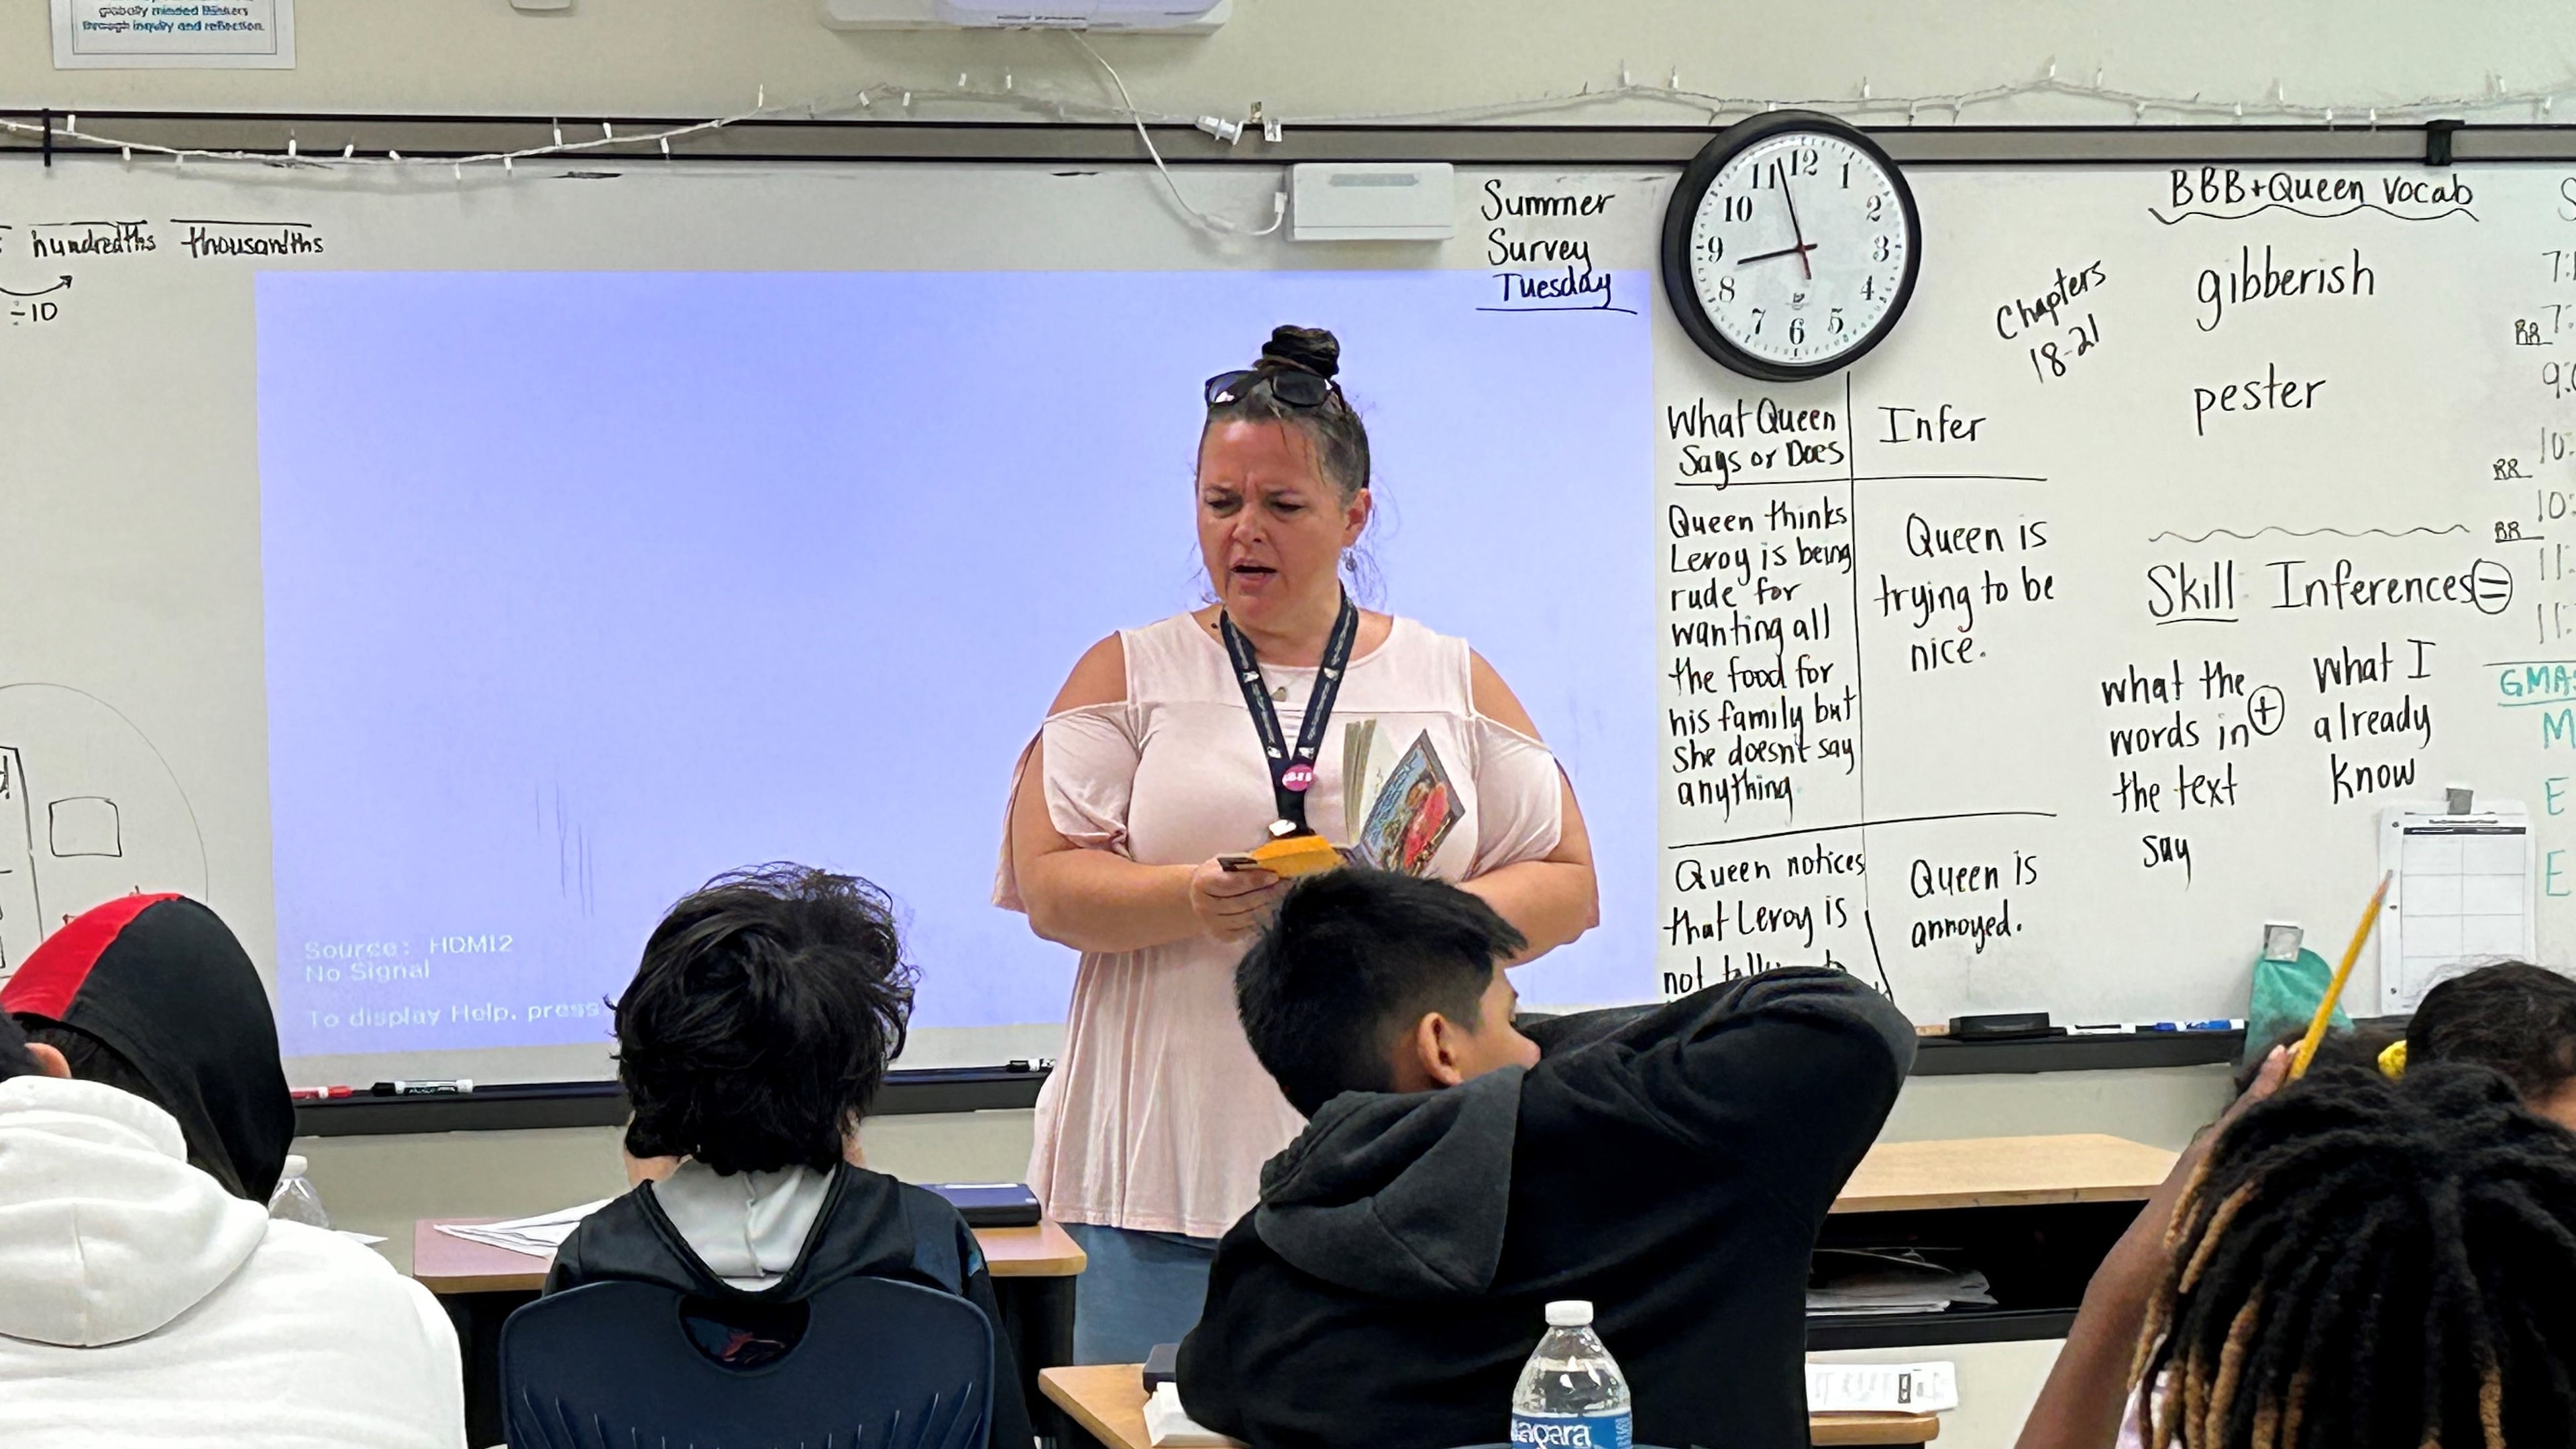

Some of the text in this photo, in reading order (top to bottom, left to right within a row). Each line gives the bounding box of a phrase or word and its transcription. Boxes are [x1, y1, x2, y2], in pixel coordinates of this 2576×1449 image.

[178, 21, 201, 31] and
[1752, 164, 1776, 189] 11
[1790, 149, 1819, 176] 12
[1840, 162, 1850, 189] 1
[1481, 179, 1615, 221] Summer
[1725, 196, 1753, 223] 10
[1866, 195, 1882, 222] 2
[32, 225, 323, 258] hundredths thousandths
[1488, 227, 1592, 272] Survey
[1708, 236, 1723, 264] 9
[1873, 235, 1889, 262] 3
[1493, 266, 1611, 308] Tuesday
[1719, 276, 1735, 303] 8
[1860, 275, 1875, 301] 4
[1997, 260, 2106, 339] Chapters
[2196, 245, 2374, 331] gibberish
[1752, 308, 1766, 335] 7
[1788, 318, 1805, 345] 6
[1828, 308, 1844, 334] 5
[1668, 397, 1835, 439] What Queen
[2194, 363, 2326, 436] pester
[1878, 404, 1986, 443] Infer
[1679, 439, 1845, 490] Says or Does
[1669, 495, 1847, 538] Queen thinks
[1907, 513, 2047, 557] Queen is
[1672, 536, 1851, 586] Leroy is being
[1672, 576, 1803, 611] rude for
[1873, 566, 2054, 633] trying to be
[2265, 559, 2475, 610] Inferences
[1672, 602, 1830, 655] wanting all
[1668, 653, 1833, 696] the food for
[2407, 639, 2436, 679] I
[2102, 659, 2245, 706] what the
[1669, 685, 1857, 742] his family but
[2110, 710, 2249, 757] words in
[2314, 694, 2431, 749] already
[1818, 738, 1855, 775] say
[2112, 762, 2238, 813] the text
[1676, 843, 1866, 892] Queen notices
[1911, 859, 1998, 899] Queen
[2143, 835, 2192, 891] say
[1663, 896, 1847, 948] that Leroy is
[305, 934, 514, 961] Source: HDMI2
[306, 959, 431, 982] No Signal
[311, 1010, 339, 1028] To
[350, 1007, 440, 1028] display
[529, 1002, 600, 1023] press
